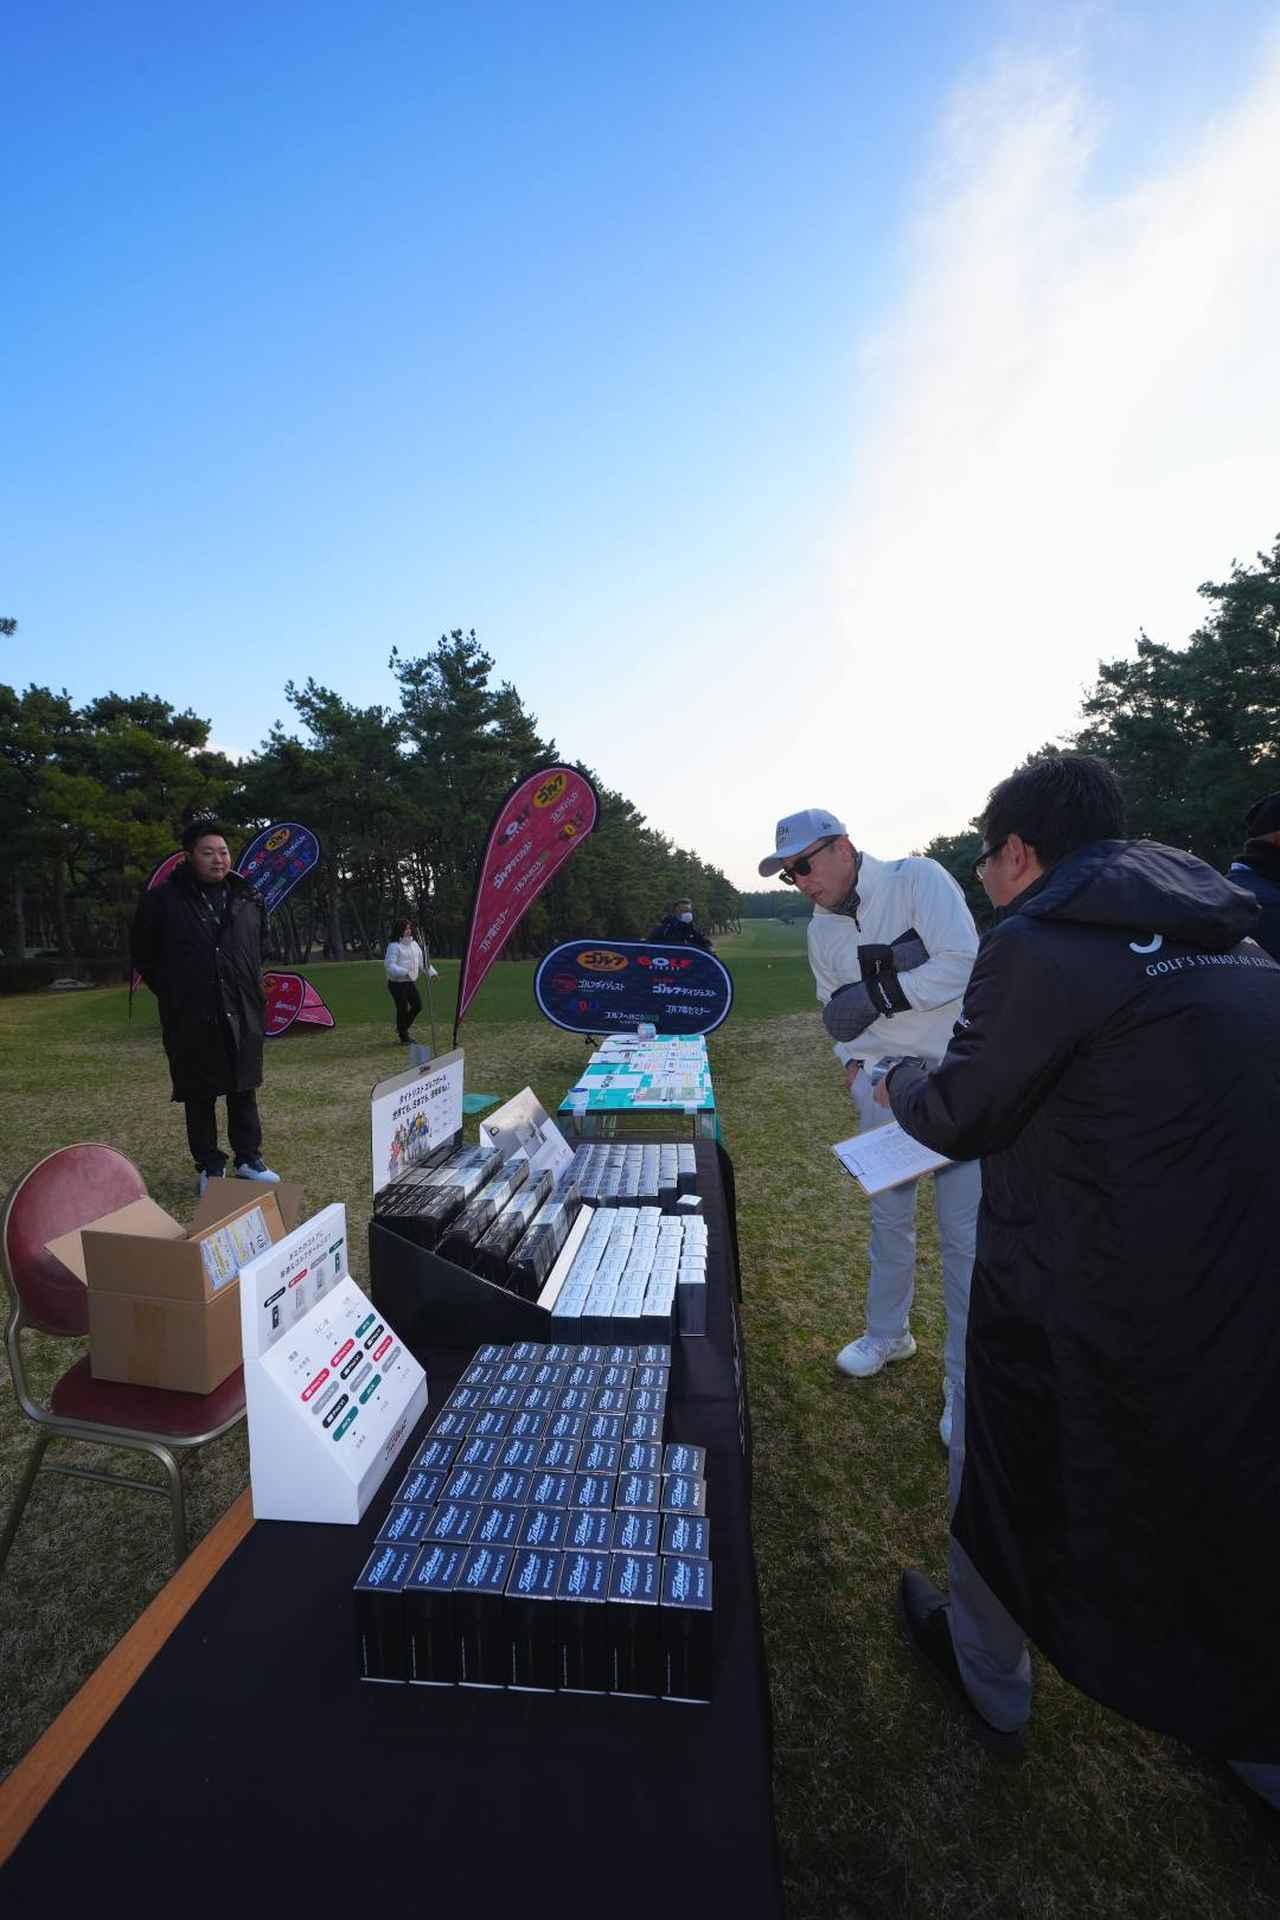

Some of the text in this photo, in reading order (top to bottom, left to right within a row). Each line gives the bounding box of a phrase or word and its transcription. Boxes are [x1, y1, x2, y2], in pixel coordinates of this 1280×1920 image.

[585, 952, 624, 969] ゴルフ
[1146, 955, 1195, 976] GOLF'S
[1197, 954, 1238, 966] SYMBOL
[419, 1441, 438, 1466] Titleist
[463, 1438, 480, 1463] Titleist
[503, 1439, 520, 1465] Titleist
[544, 1440, 559, 1465] Titleist
[586, 1442, 599, 1468] Titleist
[628, 1443, 640, 1469] Titleist
[672, 1445, 682, 1472] Titleist
[402, 1472, 424, 1501] Titleist
[448, 1469, 468, 1497] Titleist
[491, 1471, 509, 1500] Titleist
[534, 1473, 550, 1503] Titleist
[578, 1476, 592, 1506] Titleist
[624, 1474, 637, 1504] Titleist
[671, 1477, 682, 1507] Titleist
[386, 1506, 410, 1539] Titleist
[434, 1504, 455, 1536] Titleist
[479, 1507, 499, 1540] Titleist
[526, 1510, 544, 1544] Titleist
[573, 1512, 589, 1546] Titleist
[620, 1513, 634, 1547] Titleist
[672, 1516, 684, 1551] Titleist
[367, 1546, 393, 1584] Titleist
[417, 1546, 441, 1584] Titleist
[466, 1547, 487, 1586] Titleist
[517, 1552, 536, 1591] Titleist
[567, 1554, 584, 1594] Titleist
[619, 1556, 634, 1596] Titleist
[671, 1559, 684, 1600] Titleist
